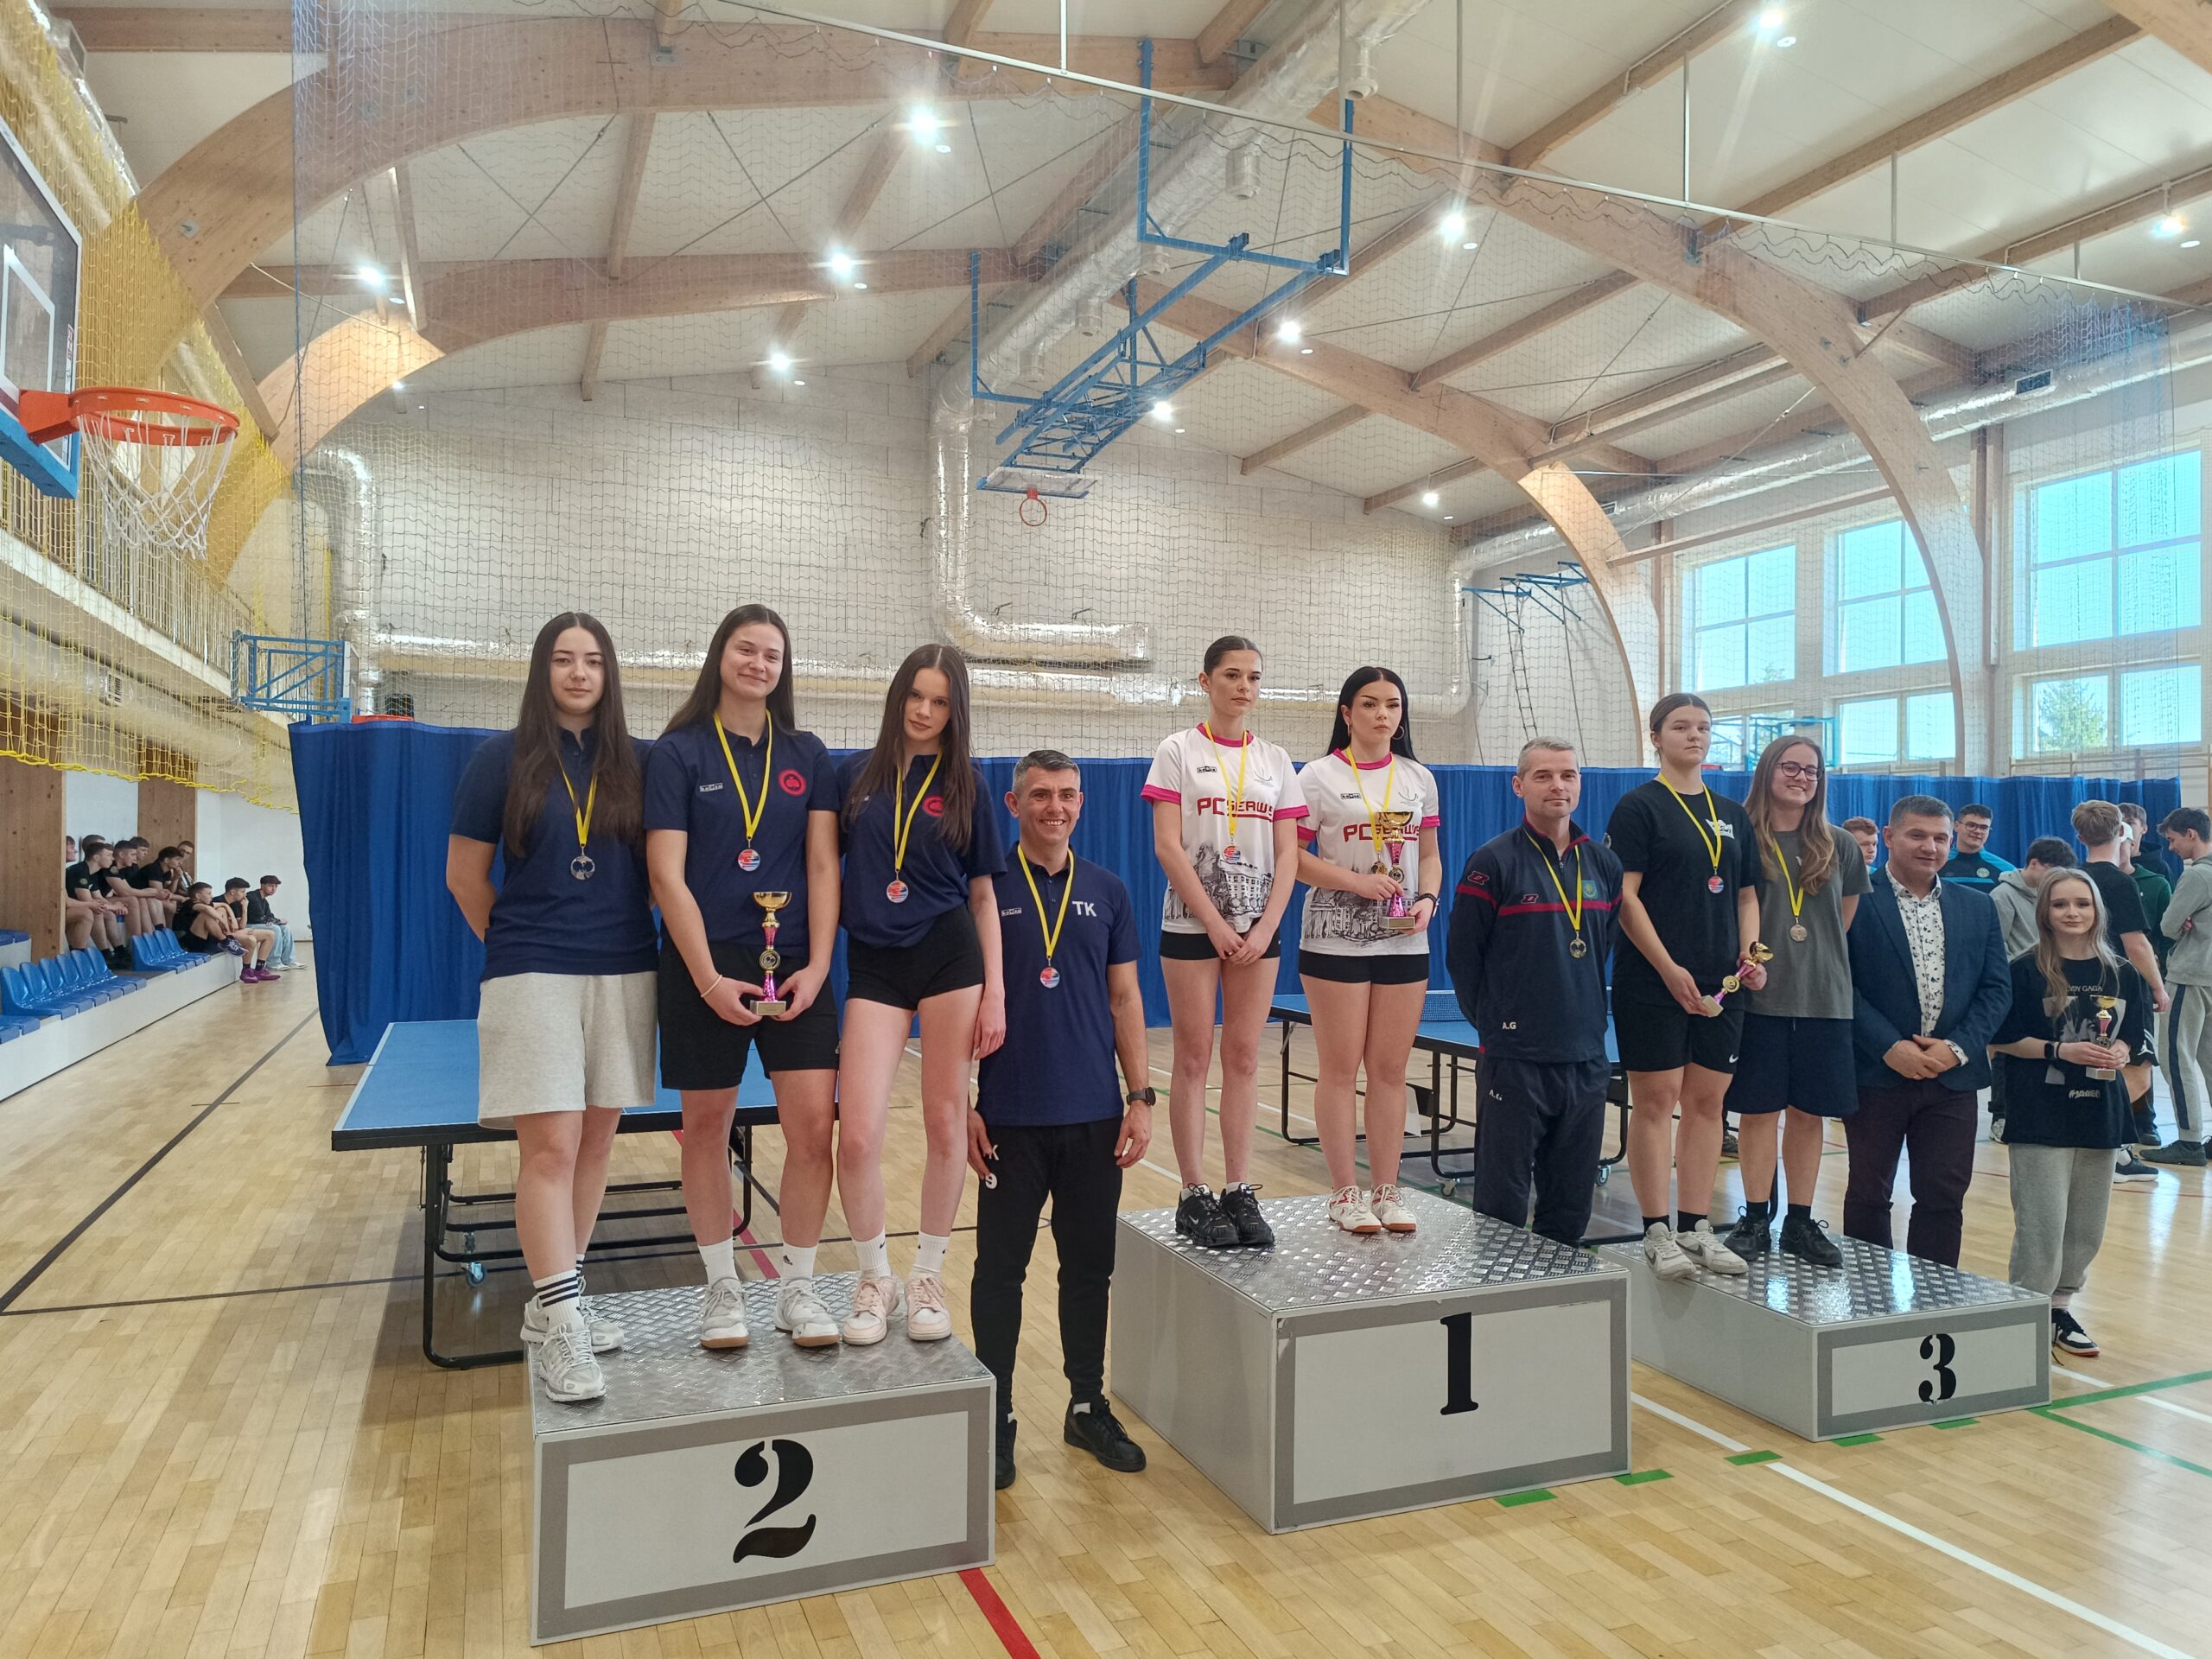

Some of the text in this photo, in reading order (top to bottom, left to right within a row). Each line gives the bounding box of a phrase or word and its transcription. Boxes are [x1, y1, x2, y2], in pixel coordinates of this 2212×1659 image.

[1072, 901, 1096, 917] TK
[1440, 1312, 1478, 1415] 1
[1919, 1333, 1956, 1404] 3
[734, 1440, 816, 1563] 2
